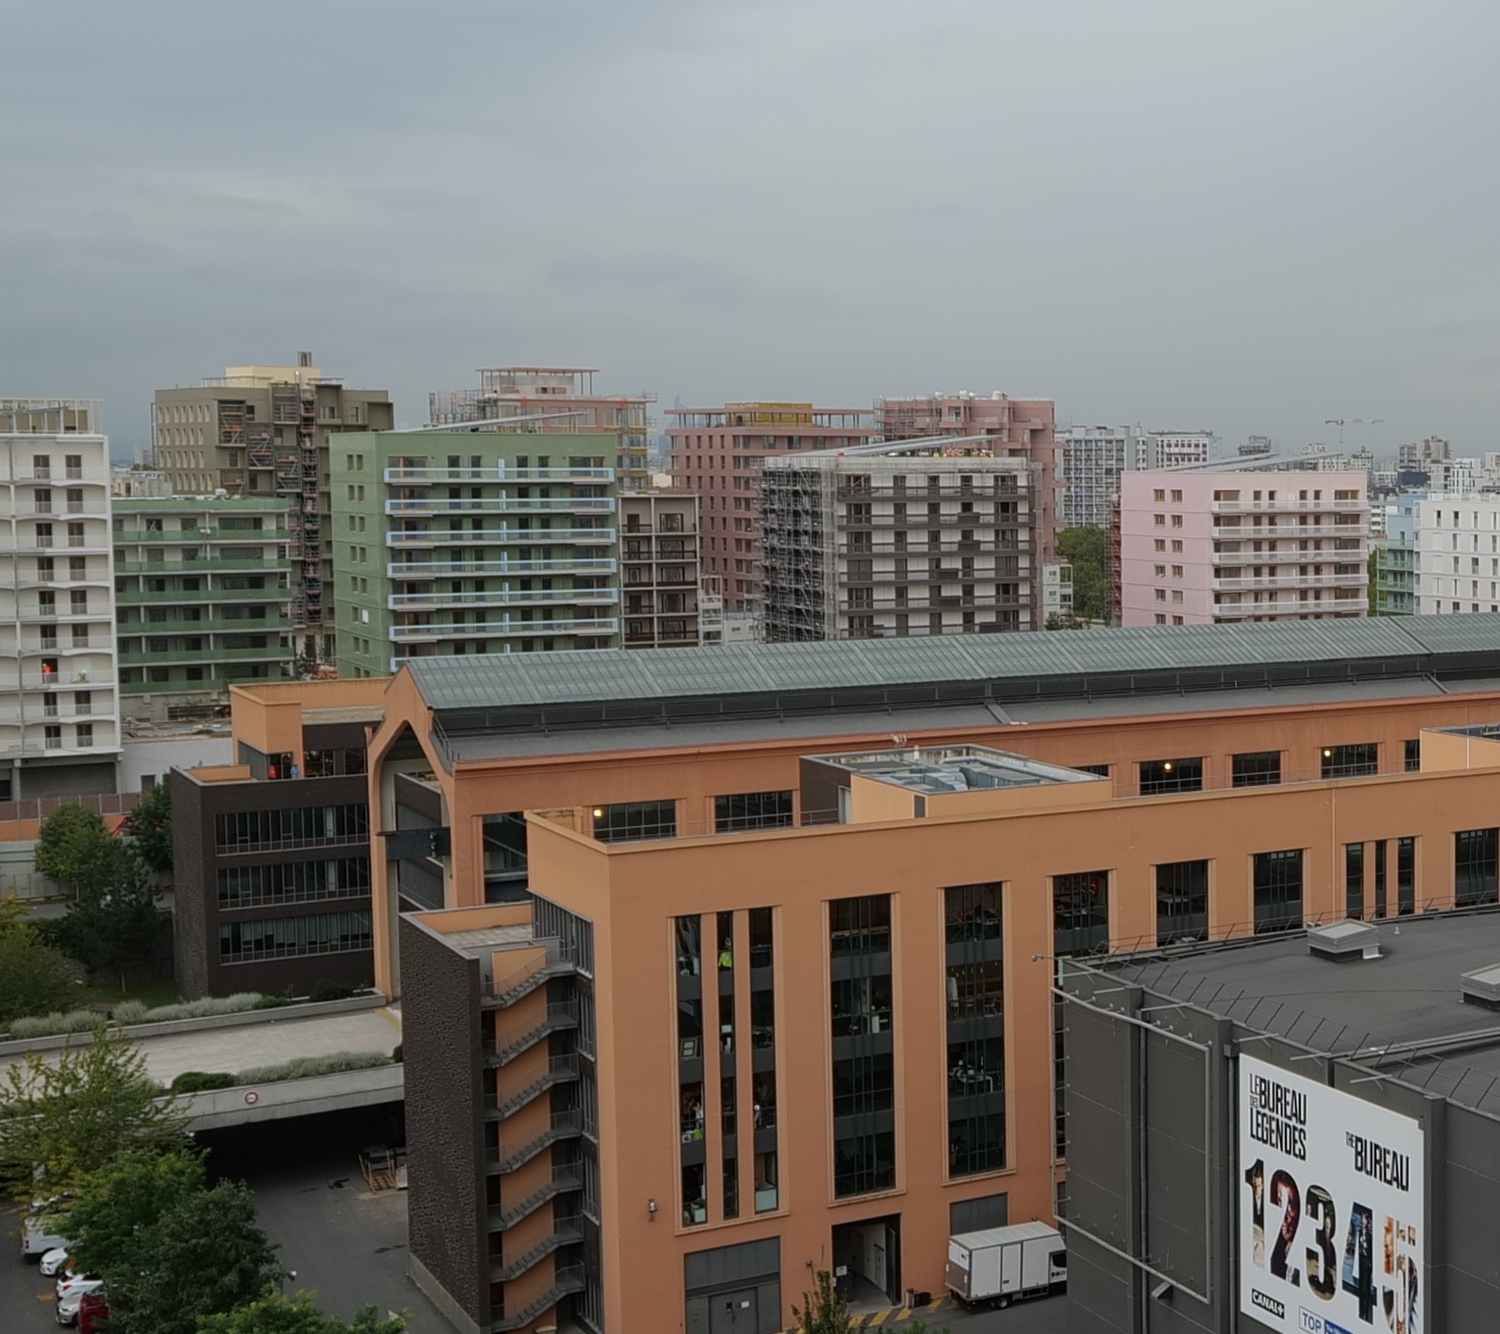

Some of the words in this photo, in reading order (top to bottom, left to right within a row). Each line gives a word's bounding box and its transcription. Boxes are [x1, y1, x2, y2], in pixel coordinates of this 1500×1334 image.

[1250, 1073, 1260, 1097] LE
[1259, 1078, 1307, 1126] BUREAU
[1249, 1107, 1306, 1161] LEGENDES
[1345, 1131, 1355, 1149] THE
[1354, 1136, 1409, 1192] BUREAU
[1253, 1291, 1284, 1316] CANAL+
[1302, 1312, 1322, 1333] TOP
